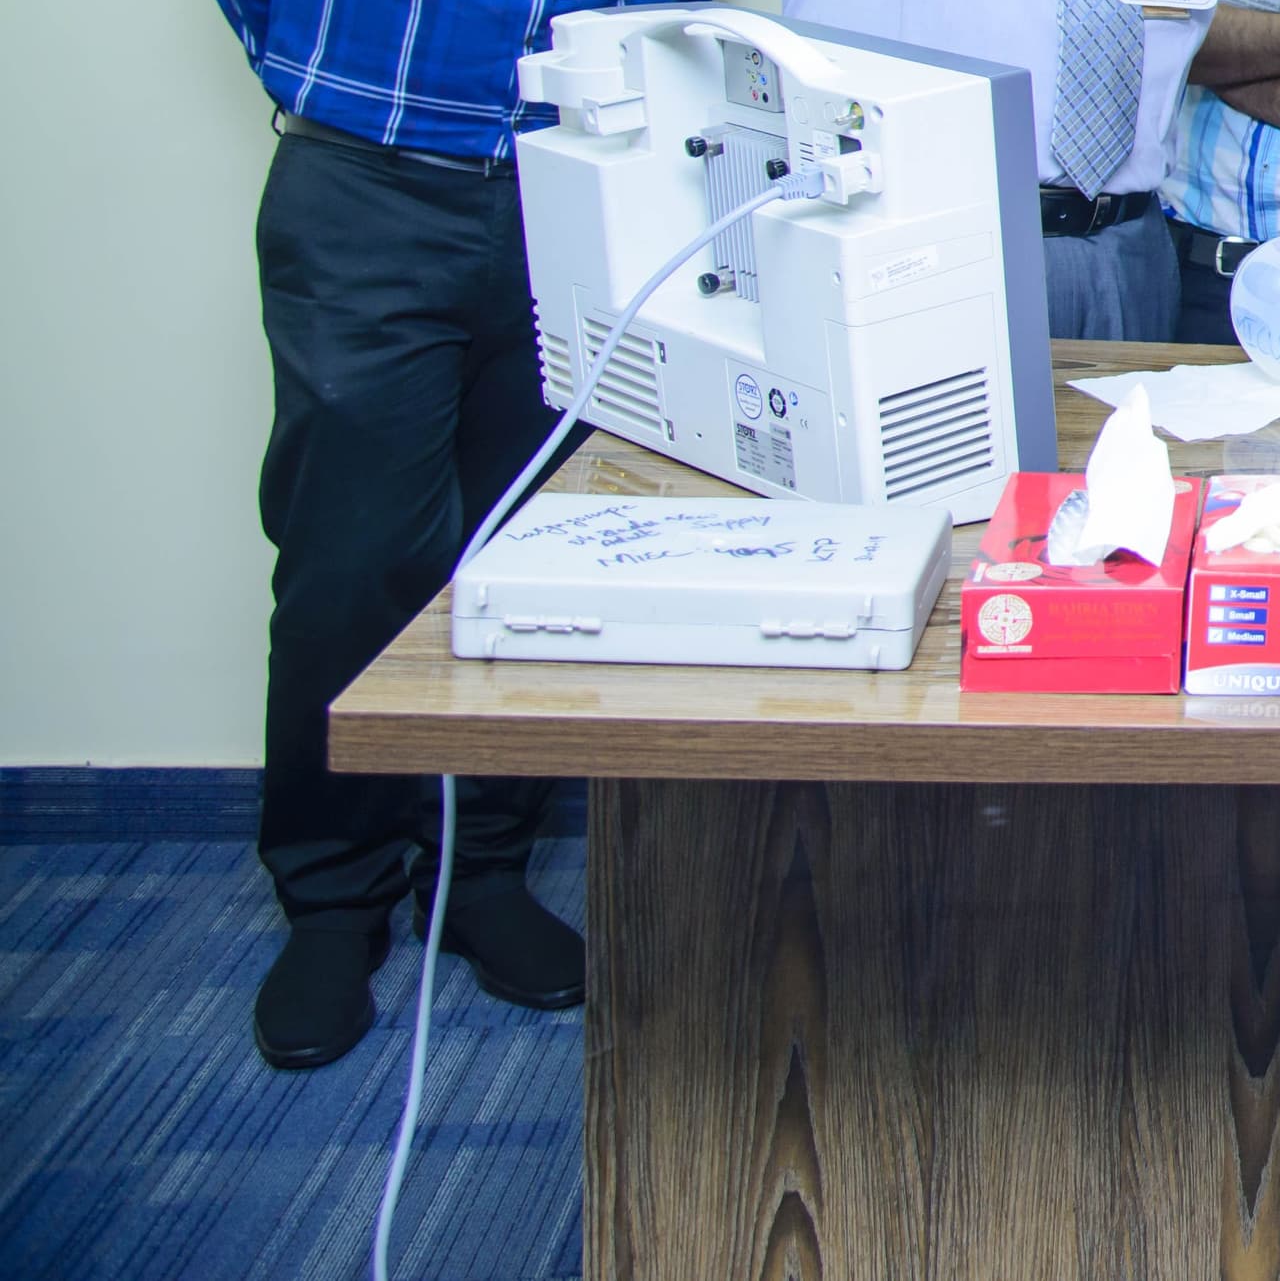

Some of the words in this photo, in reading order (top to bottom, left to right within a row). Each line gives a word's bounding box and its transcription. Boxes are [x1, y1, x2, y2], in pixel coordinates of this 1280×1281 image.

[1229, 589, 1266, 600] X-Small
[1228, 610, 1256, 621] Small
[1227, 632, 1265, 643] Medium
